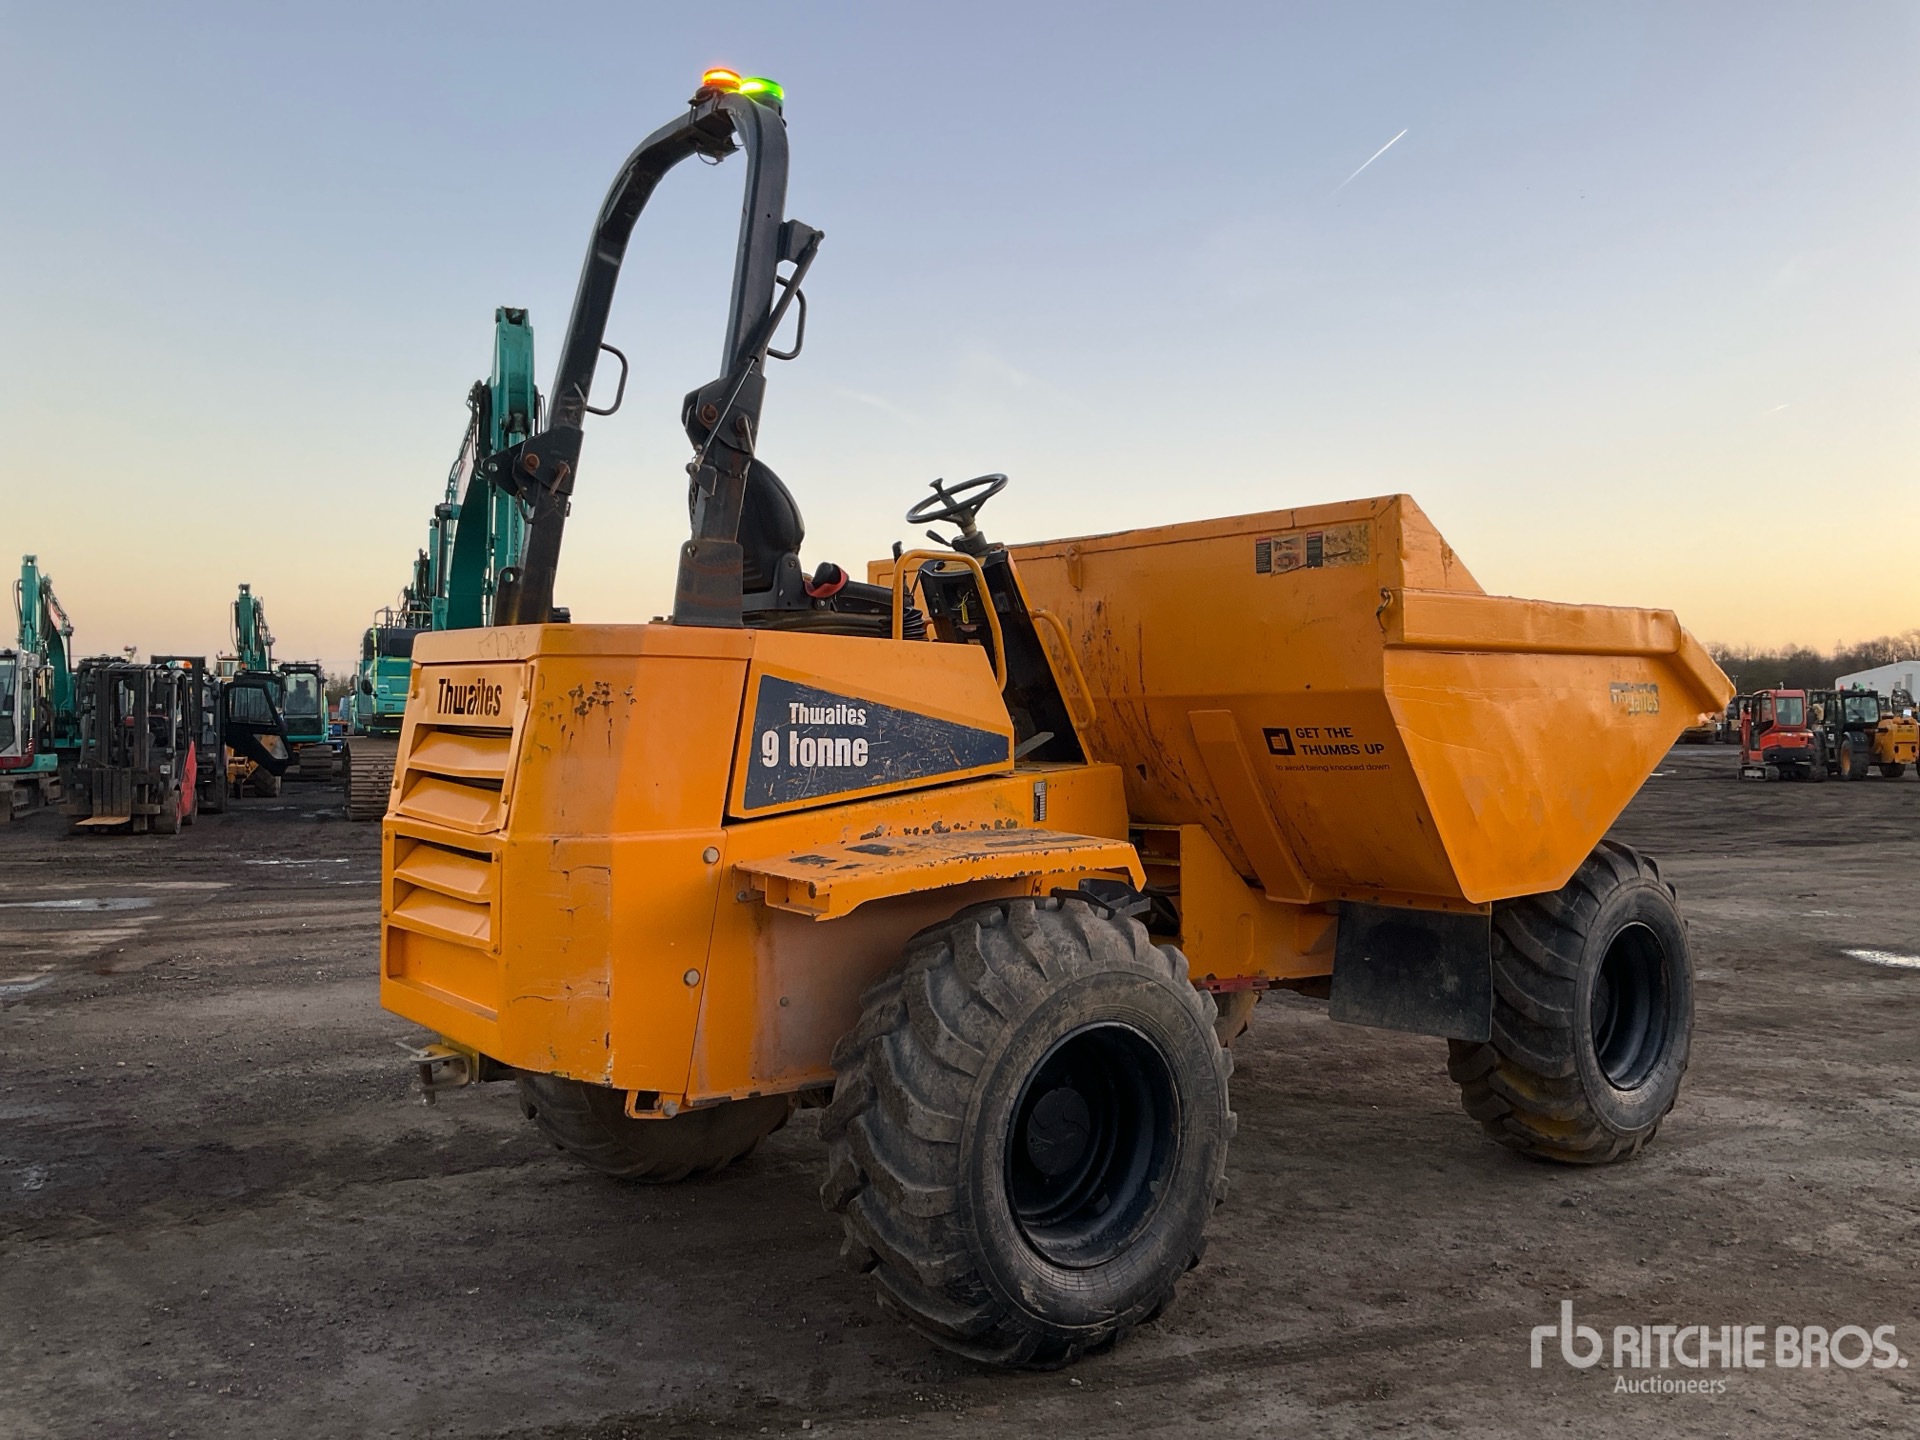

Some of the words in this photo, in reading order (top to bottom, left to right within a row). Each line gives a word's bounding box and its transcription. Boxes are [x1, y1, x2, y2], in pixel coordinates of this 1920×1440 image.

[437, 678, 503, 716] Thwaites
[789, 702, 867, 726] Thwaites
[1295, 727, 1320, 739] GET
[1324, 727, 1354, 738] THE
[762, 730, 780, 767] 9
[789, 730, 869, 767] tonne
[1300, 744, 1360, 755] THUMBS
[1364, 743, 1385, 755] UP
[1306, 764, 1329, 773] being
[1329, 763, 1365, 771] knocked
